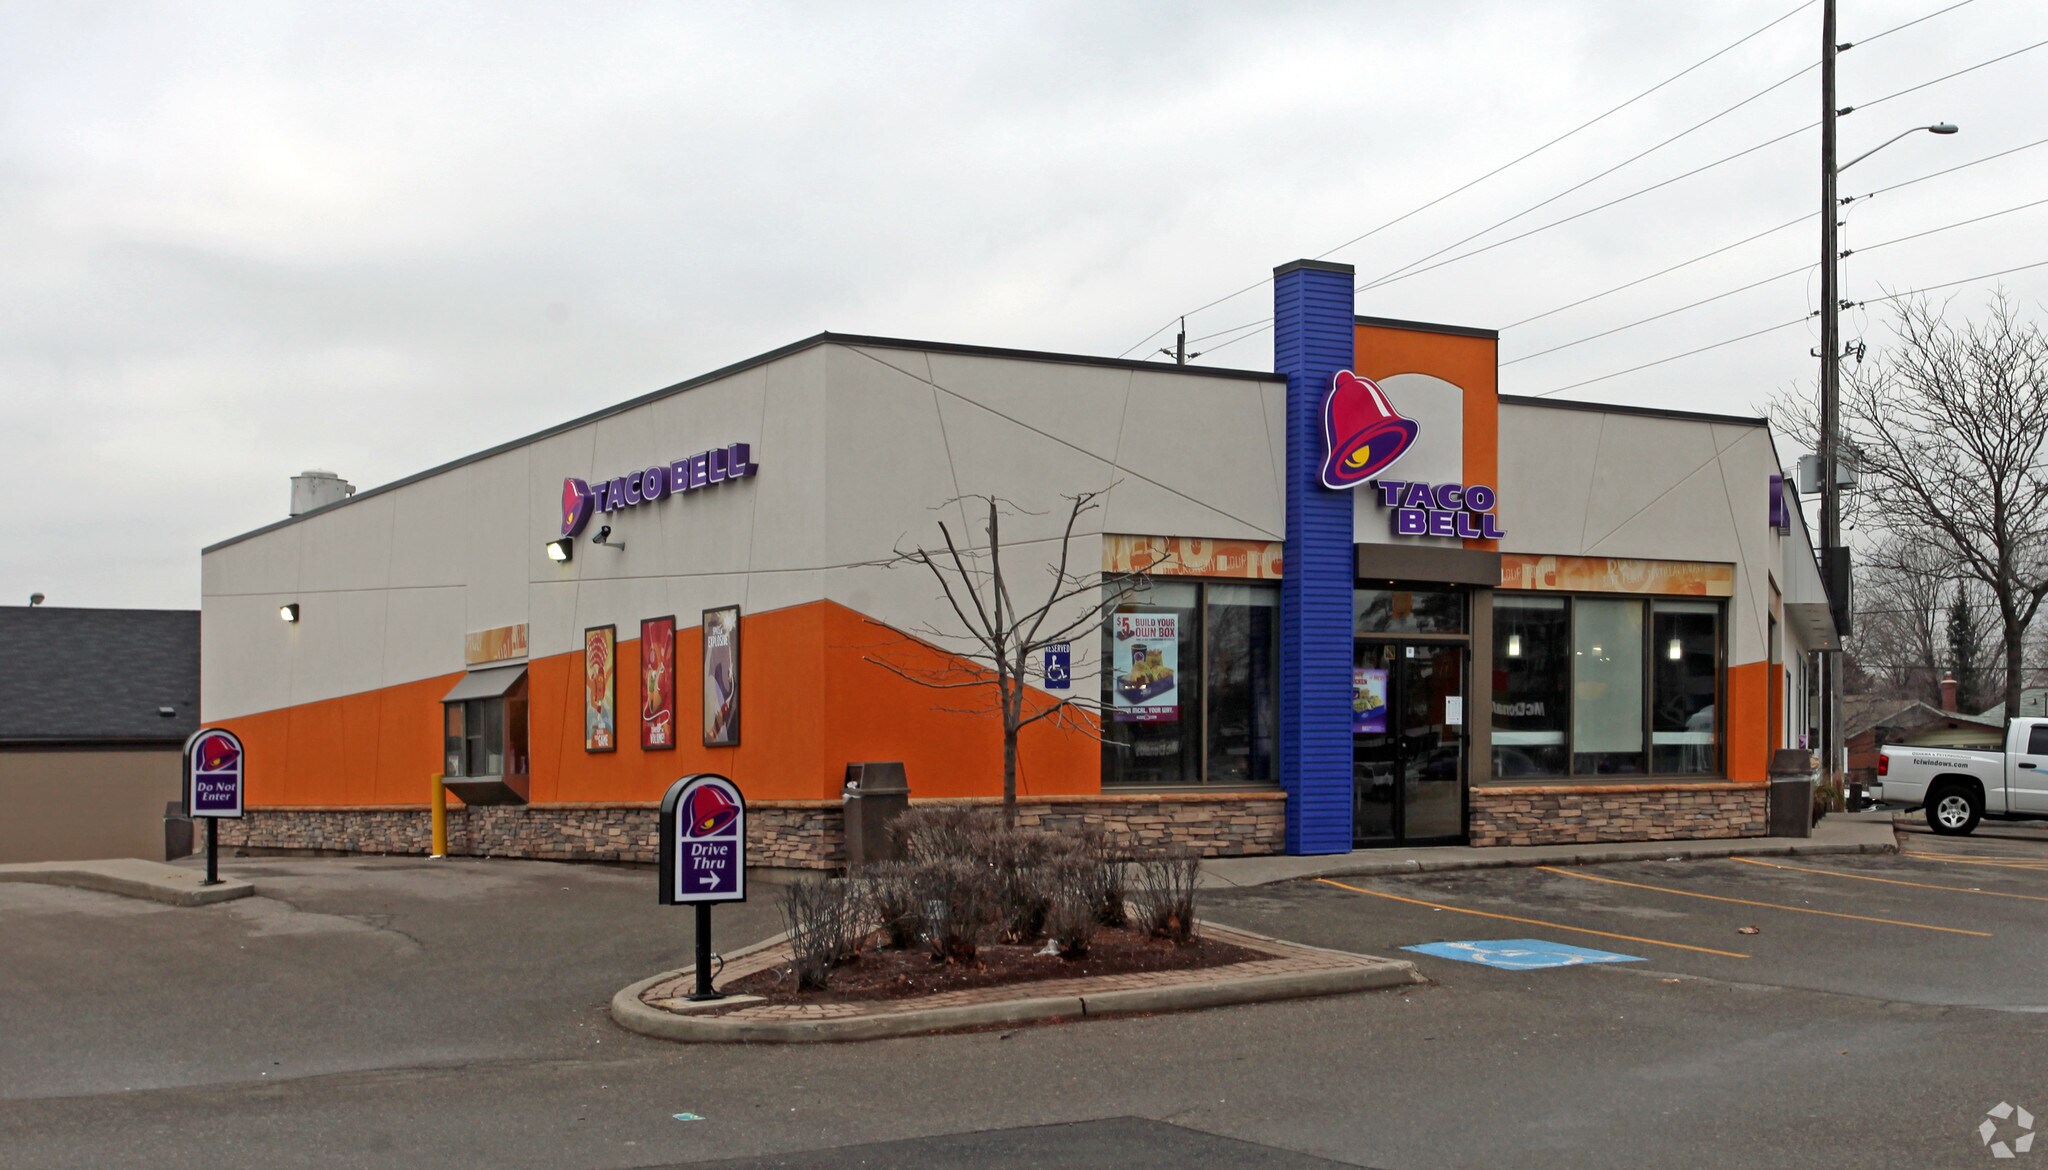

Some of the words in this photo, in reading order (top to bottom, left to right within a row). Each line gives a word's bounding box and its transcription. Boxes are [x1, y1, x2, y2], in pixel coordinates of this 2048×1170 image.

[591, 466, 664, 513] TACO
[670, 443, 750, 494] BELL
[1377, 479, 1496, 512] TACO
[1398, 508, 1508, 539] BELL
[1135, 618, 1156, 627] BUILD
[1157, 618, 1175, 627] YOUR
[1135, 627, 1156, 637] OWN
[1158, 627, 1175, 637] BOX
[197, 782, 213, 792] Do
[216, 782, 236, 792] Not
[202, 792, 231, 801] Enter
[691, 843, 728, 856] Drive
[694, 857, 726, 870] Thru
